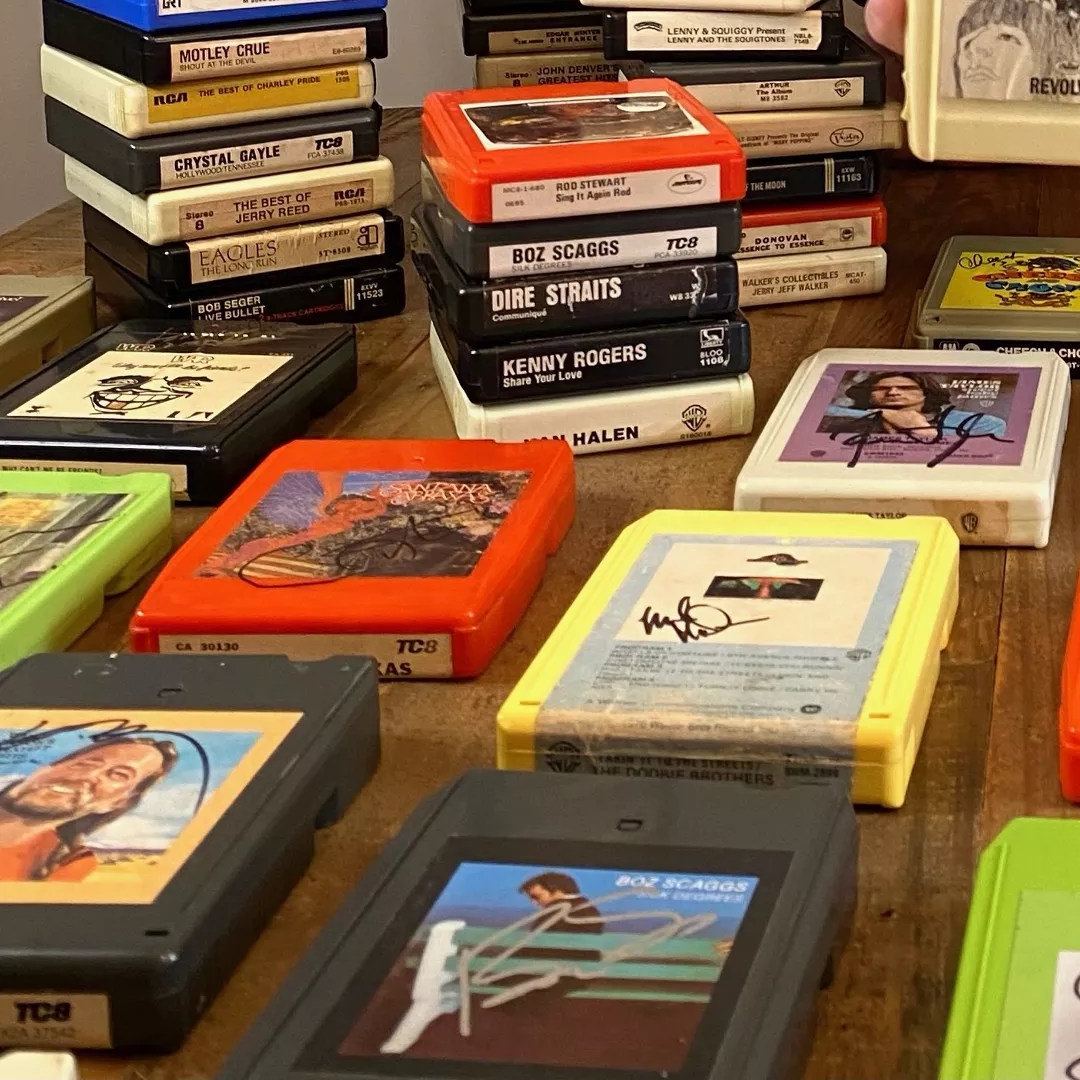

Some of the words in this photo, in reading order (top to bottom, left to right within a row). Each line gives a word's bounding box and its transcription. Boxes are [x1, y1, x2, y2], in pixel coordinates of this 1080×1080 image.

[180, 46, 230, 63] MOTLEY
[236, 42, 270, 58] CRUE
[174, 149, 236, 171] CRYSTAL
[239, 145, 280, 162] GAYLE
[556, 182, 577, 192] ROD
[581, 177, 627, 190] STEWART
[233, 200, 258, 212] THE
[262, 196, 292, 210] BEST
[295, 192, 312, 204] OF
[236, 209, 274, 224] JERRY
[278, 204, 310, 219] REED
[200, 240, 277, 265] EAGLES
[512, 247, 546, 264] BOZ
[551, 239, 620, 262] SCAGGS
[666, 237, 699, 251] TC8
[197, 300, 222, 314] BOB
[224, 296, 261, 311] SEGER
[492, 287, 535, 312] DIRE
[546, 277, 622, 309] STRAITS
[503, 355, 568, 377] KENNY
[573, 343, 647, 368] ROGERS
[503, 376, 532, 388] Share
[534, 372, 556, 384] Your
[558, 369, 582, 380] Love
[573, 426, 639, 447] HALEN
